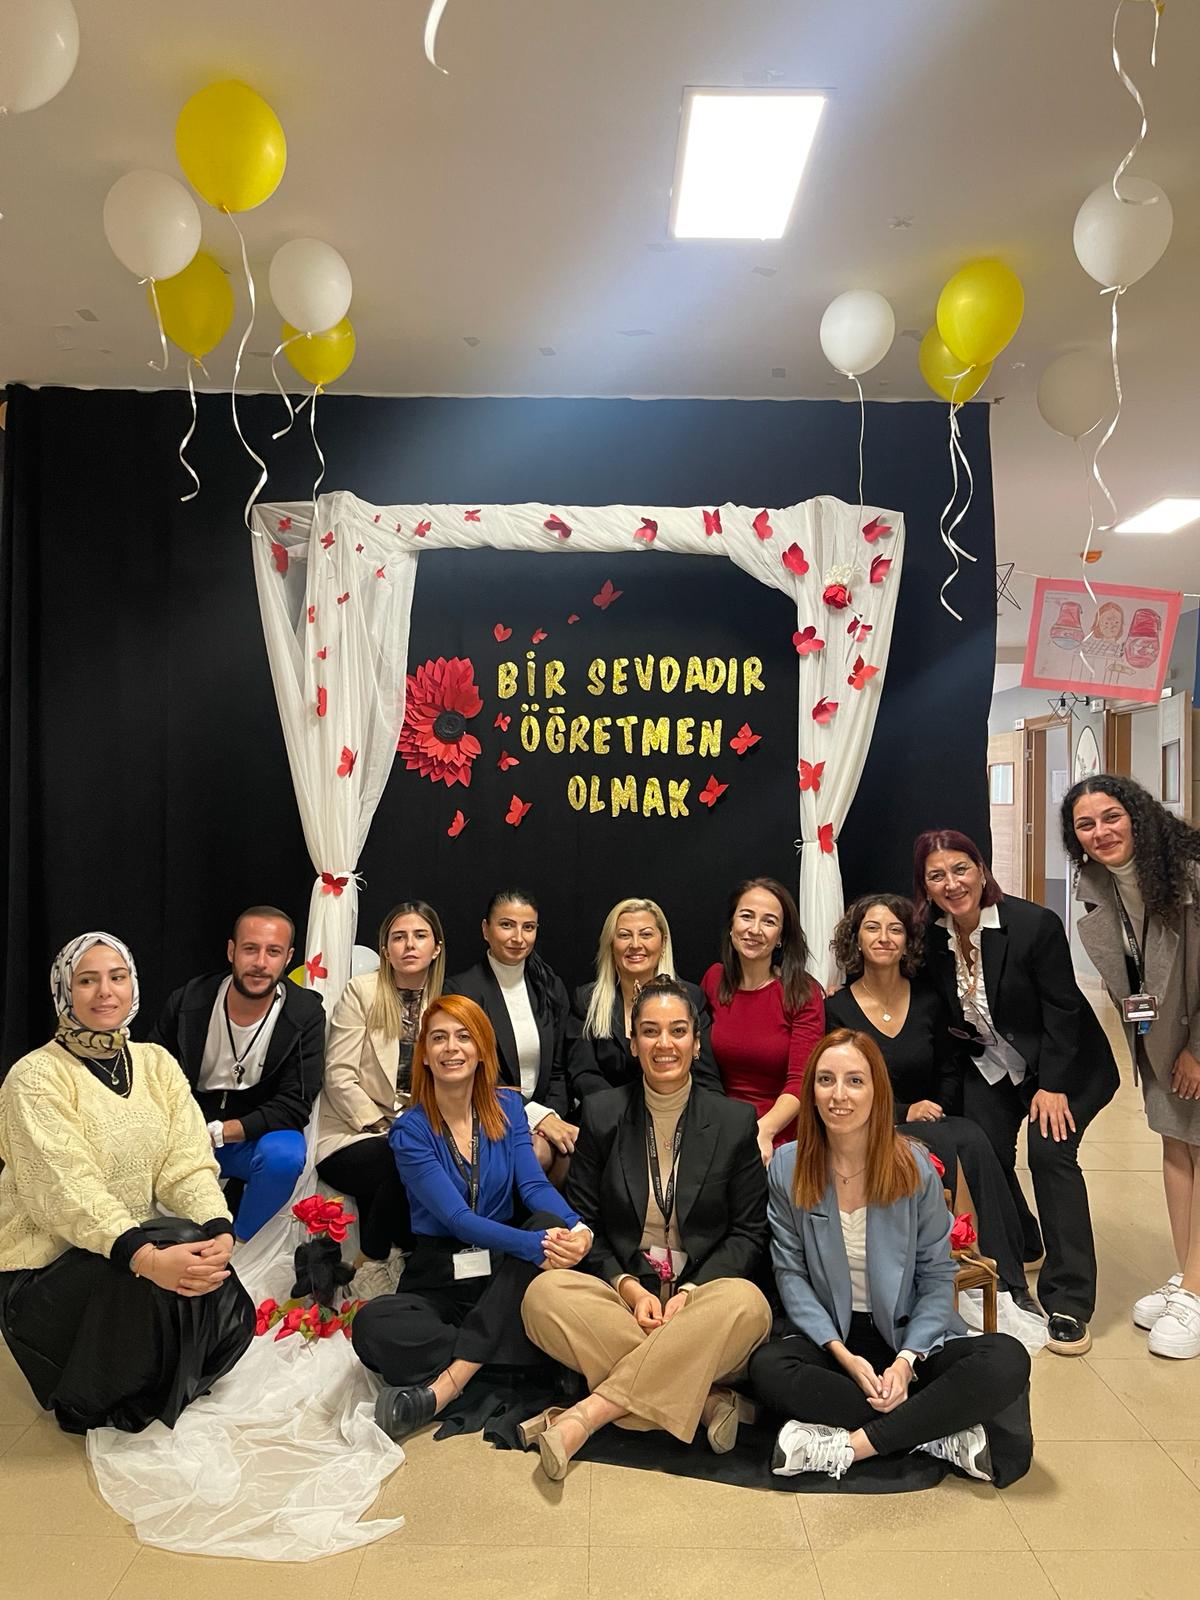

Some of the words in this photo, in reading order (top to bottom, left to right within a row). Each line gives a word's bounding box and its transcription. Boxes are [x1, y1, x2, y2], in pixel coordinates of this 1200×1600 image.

[497, 650, 567, 699] BİR
[586, 653, 766, 697] SEVDADIR
[520, 702, 723, 758] ÖĞRETMEN
[567, 774, 691, 819] OLMAK
